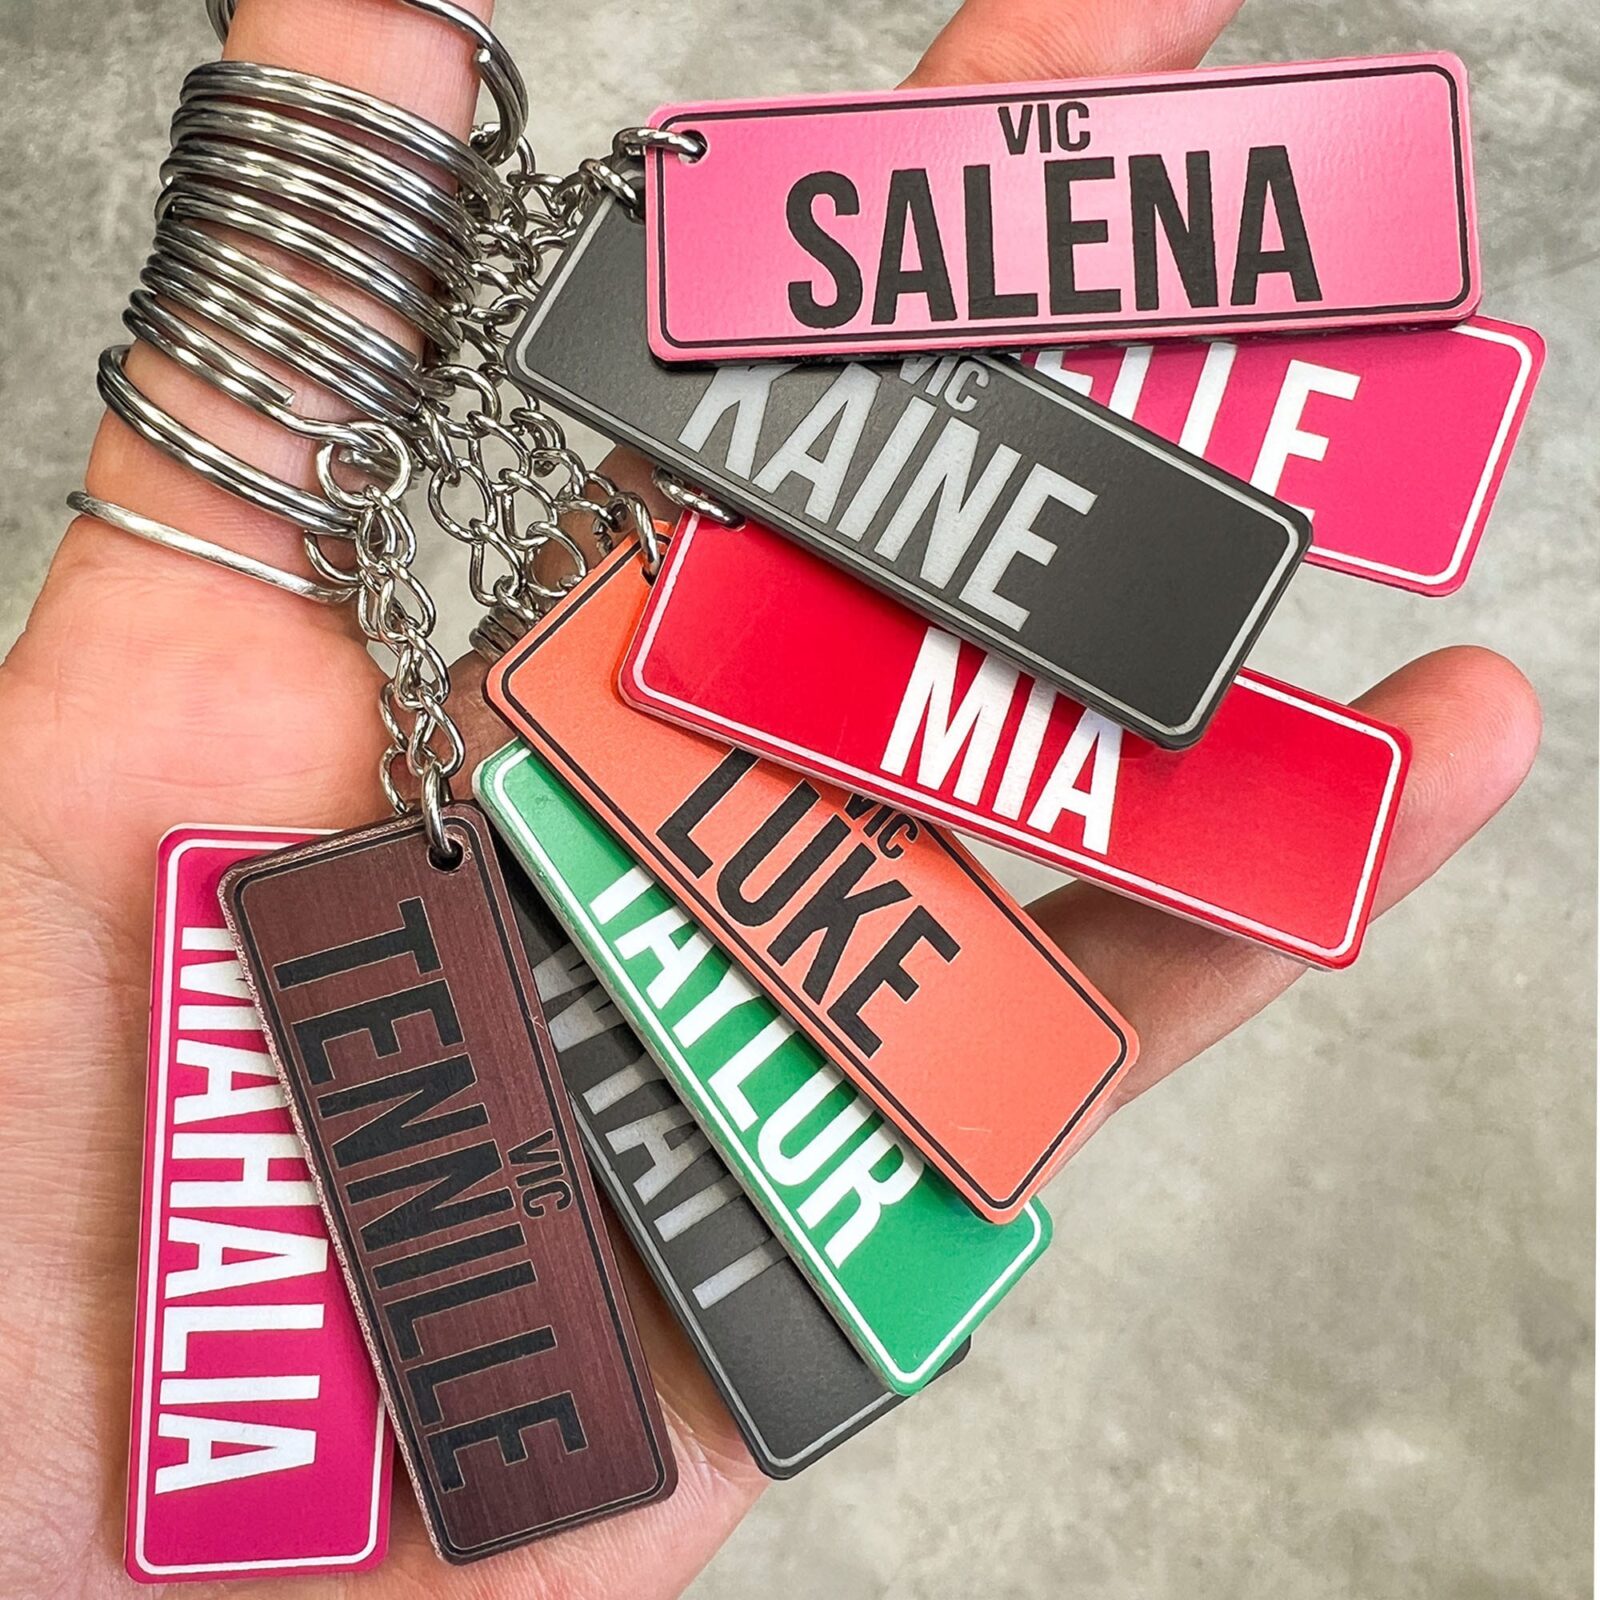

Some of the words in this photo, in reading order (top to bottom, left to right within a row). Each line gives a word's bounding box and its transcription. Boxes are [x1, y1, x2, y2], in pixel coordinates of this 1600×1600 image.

[786, 145, 1323, 330] SALENA
[997, 101, 1091, 156] VIC
[677, 361, 1098, 632] KAINE
[880, 626, 1123, 854] MIA
[655, 748, 961, 1059] LUKE
[272, 896, 588, 1494] TENNILLE
[506, 1128, 574, 1219] VIC
